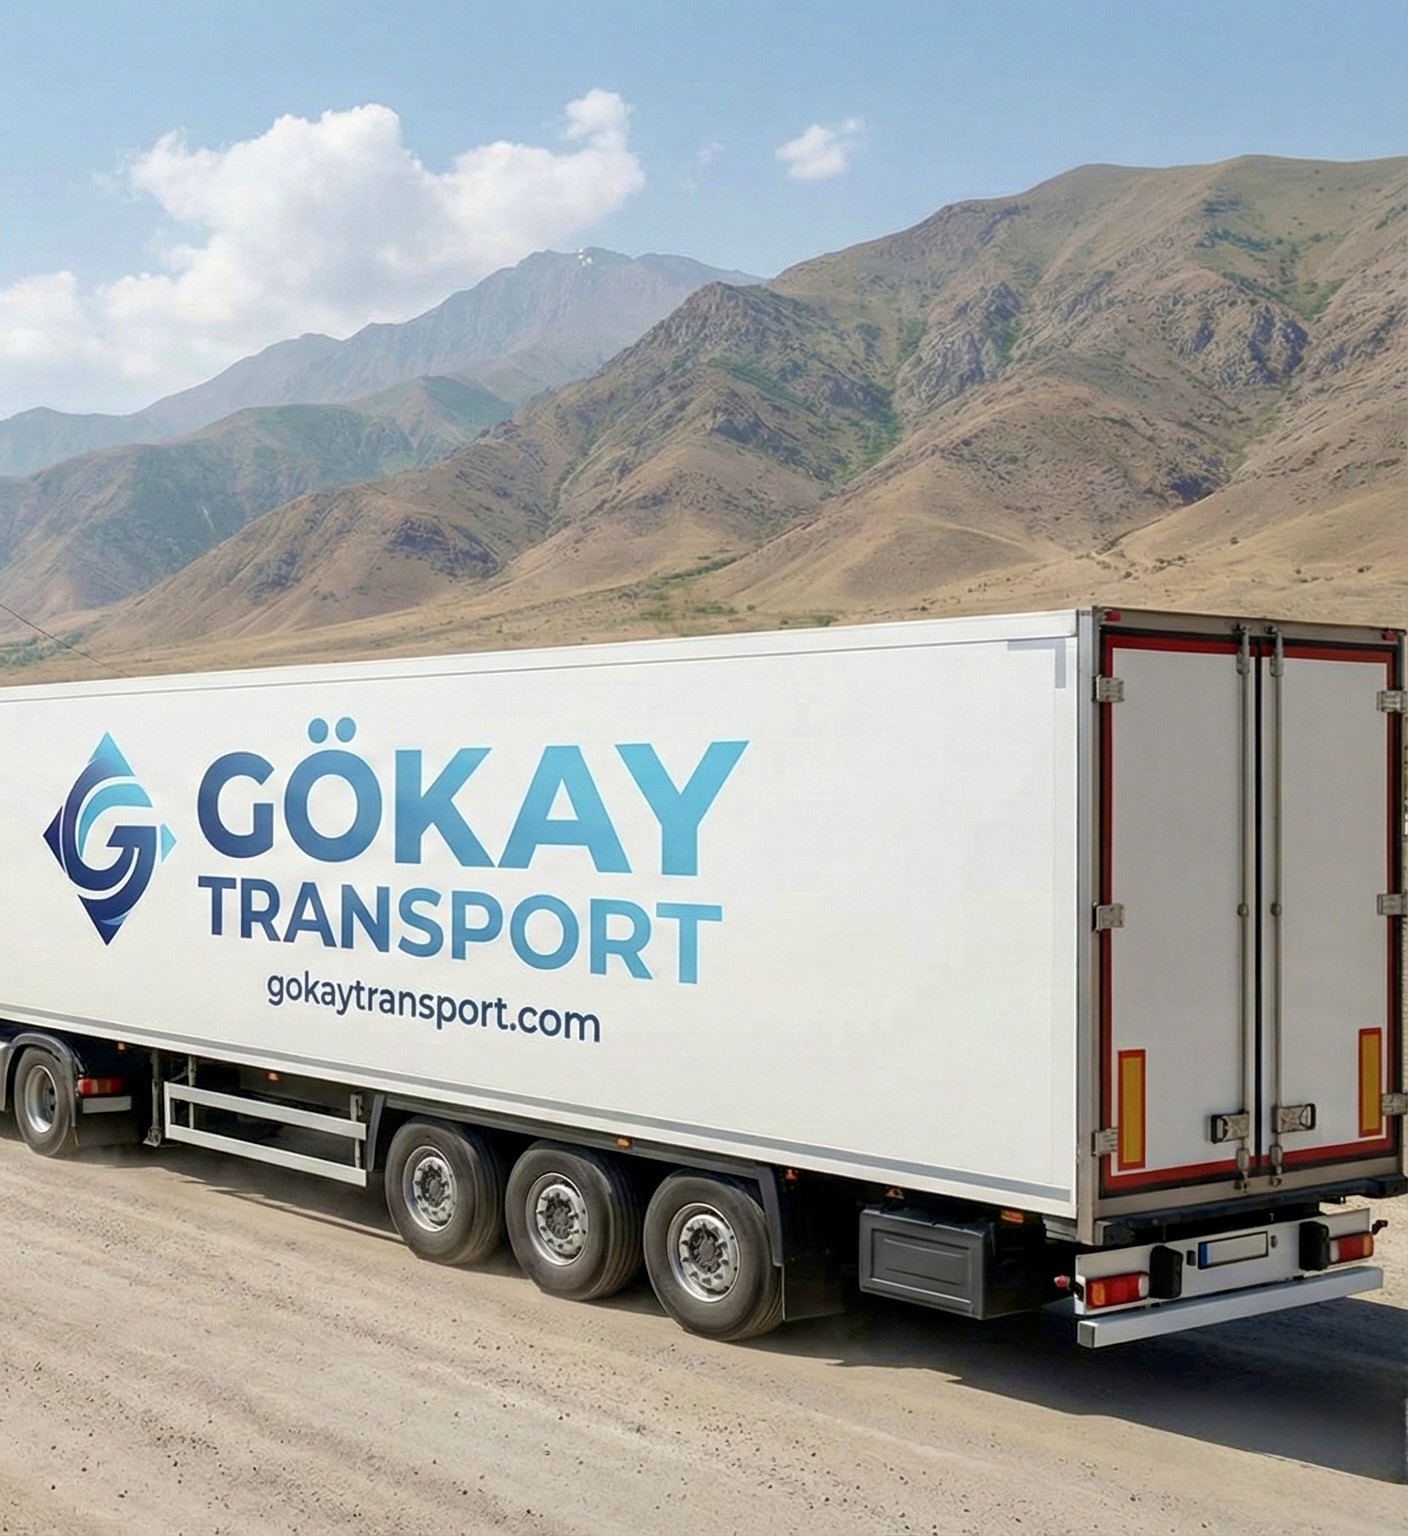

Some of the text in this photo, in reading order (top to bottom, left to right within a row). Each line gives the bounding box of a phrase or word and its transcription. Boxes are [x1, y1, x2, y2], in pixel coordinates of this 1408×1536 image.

[197, 716, 749, 878] GÖKAY
[198, 876, 724, 985] TRANSPORT
[267, 970, 601, 1043] gokaytransport.com
